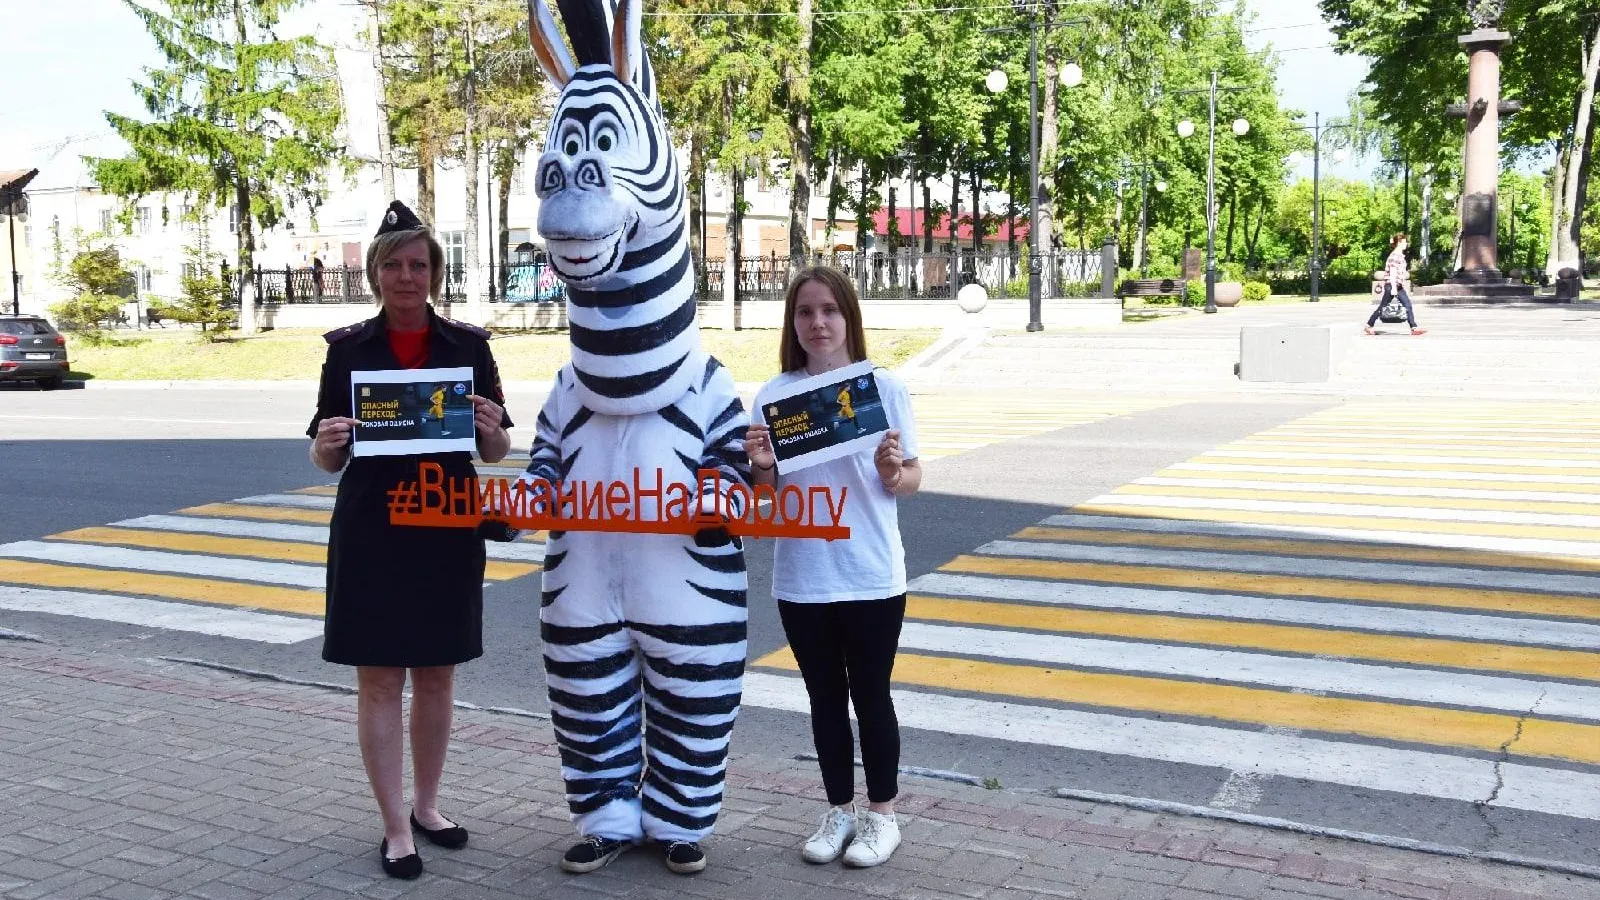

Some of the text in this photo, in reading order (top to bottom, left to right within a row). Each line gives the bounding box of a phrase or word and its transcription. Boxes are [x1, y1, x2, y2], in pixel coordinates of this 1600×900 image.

[361, 400, 399, 410] ОПАСНЫЙ
[361, 411, 396, 419] ПЕРЕХОД
[773, 411, 809, 429] ОПАСНЫЙ
[775, 422, 809, 437] ПЕРЕХОД
[387, 461, 848, 541] #ВниманиеНаДорогу
